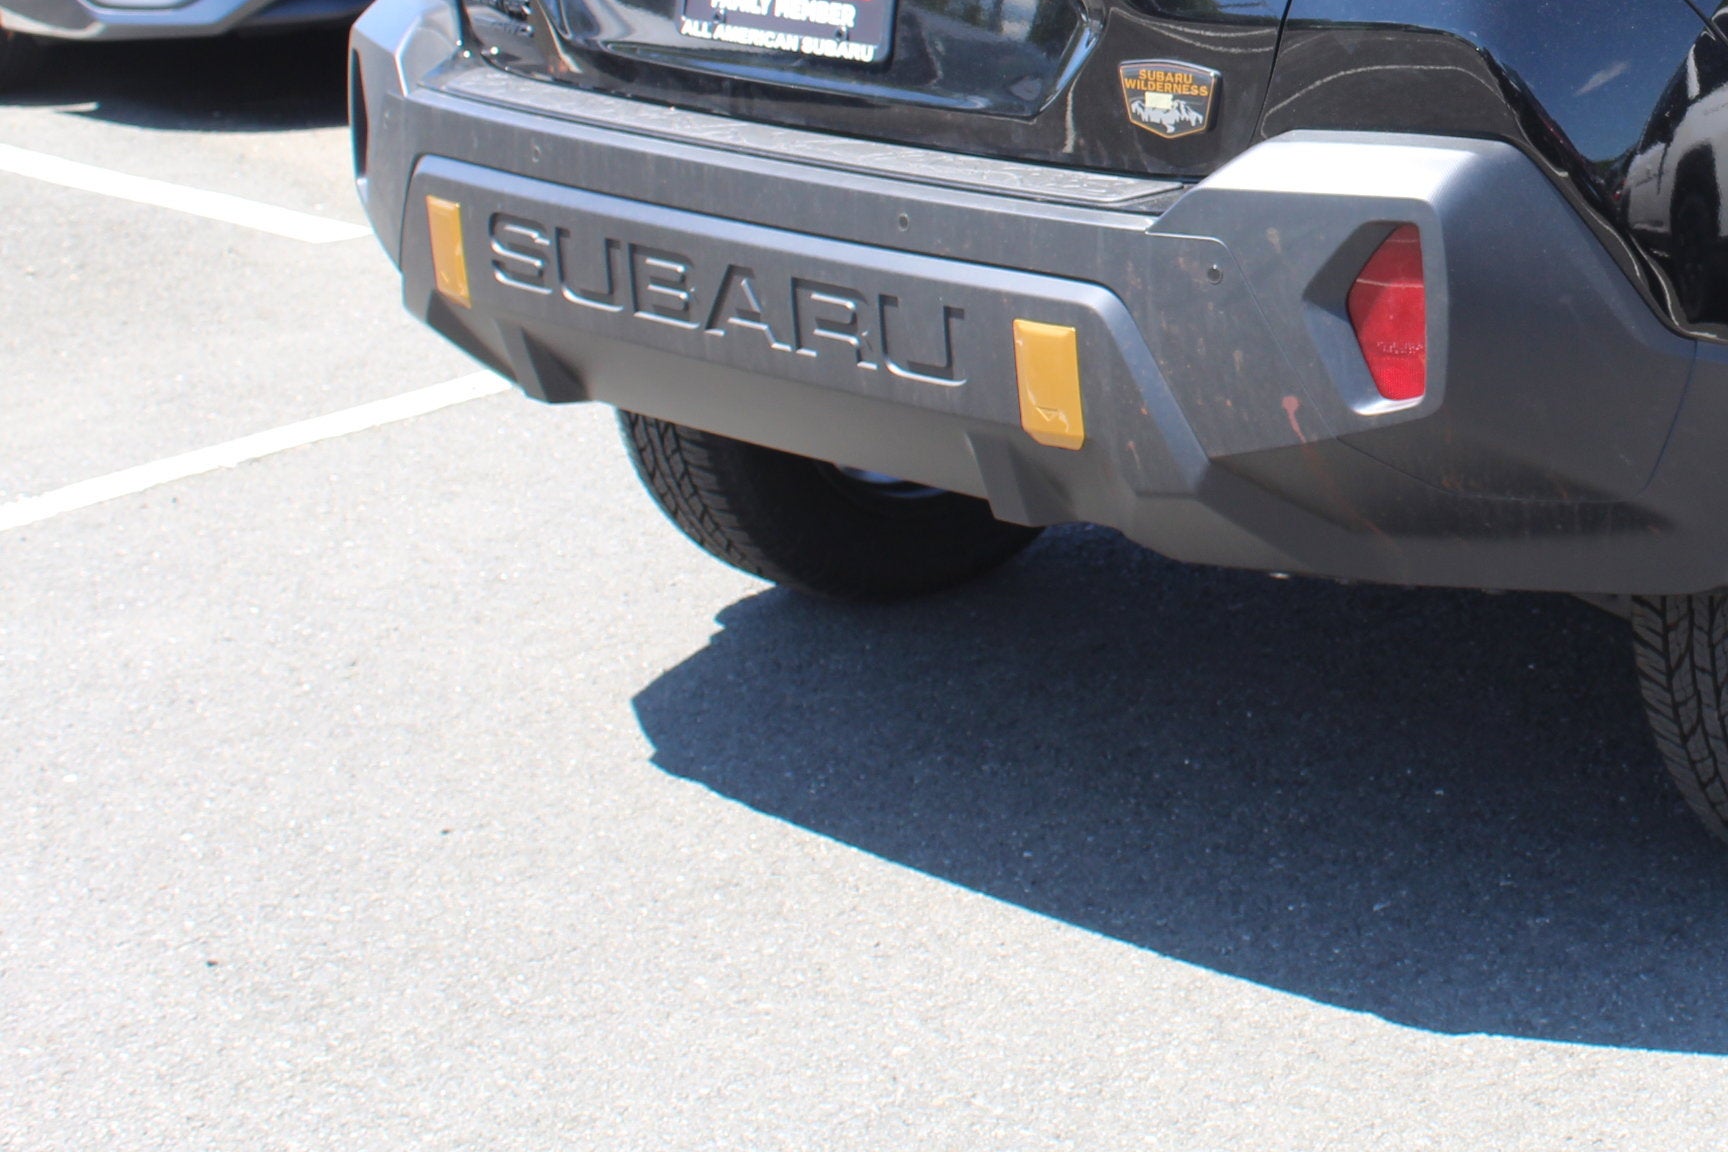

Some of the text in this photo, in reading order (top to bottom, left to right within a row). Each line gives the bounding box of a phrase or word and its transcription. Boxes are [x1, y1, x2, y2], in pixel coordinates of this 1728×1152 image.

[681, 18, 875, 62] ALL AMERICAN SUBARU
[1124, 78, 1209, 97] WILDERNESS
[1138, 69, 1193, 84] SUBARU
[488, 211, 967, 388] SUBARU
